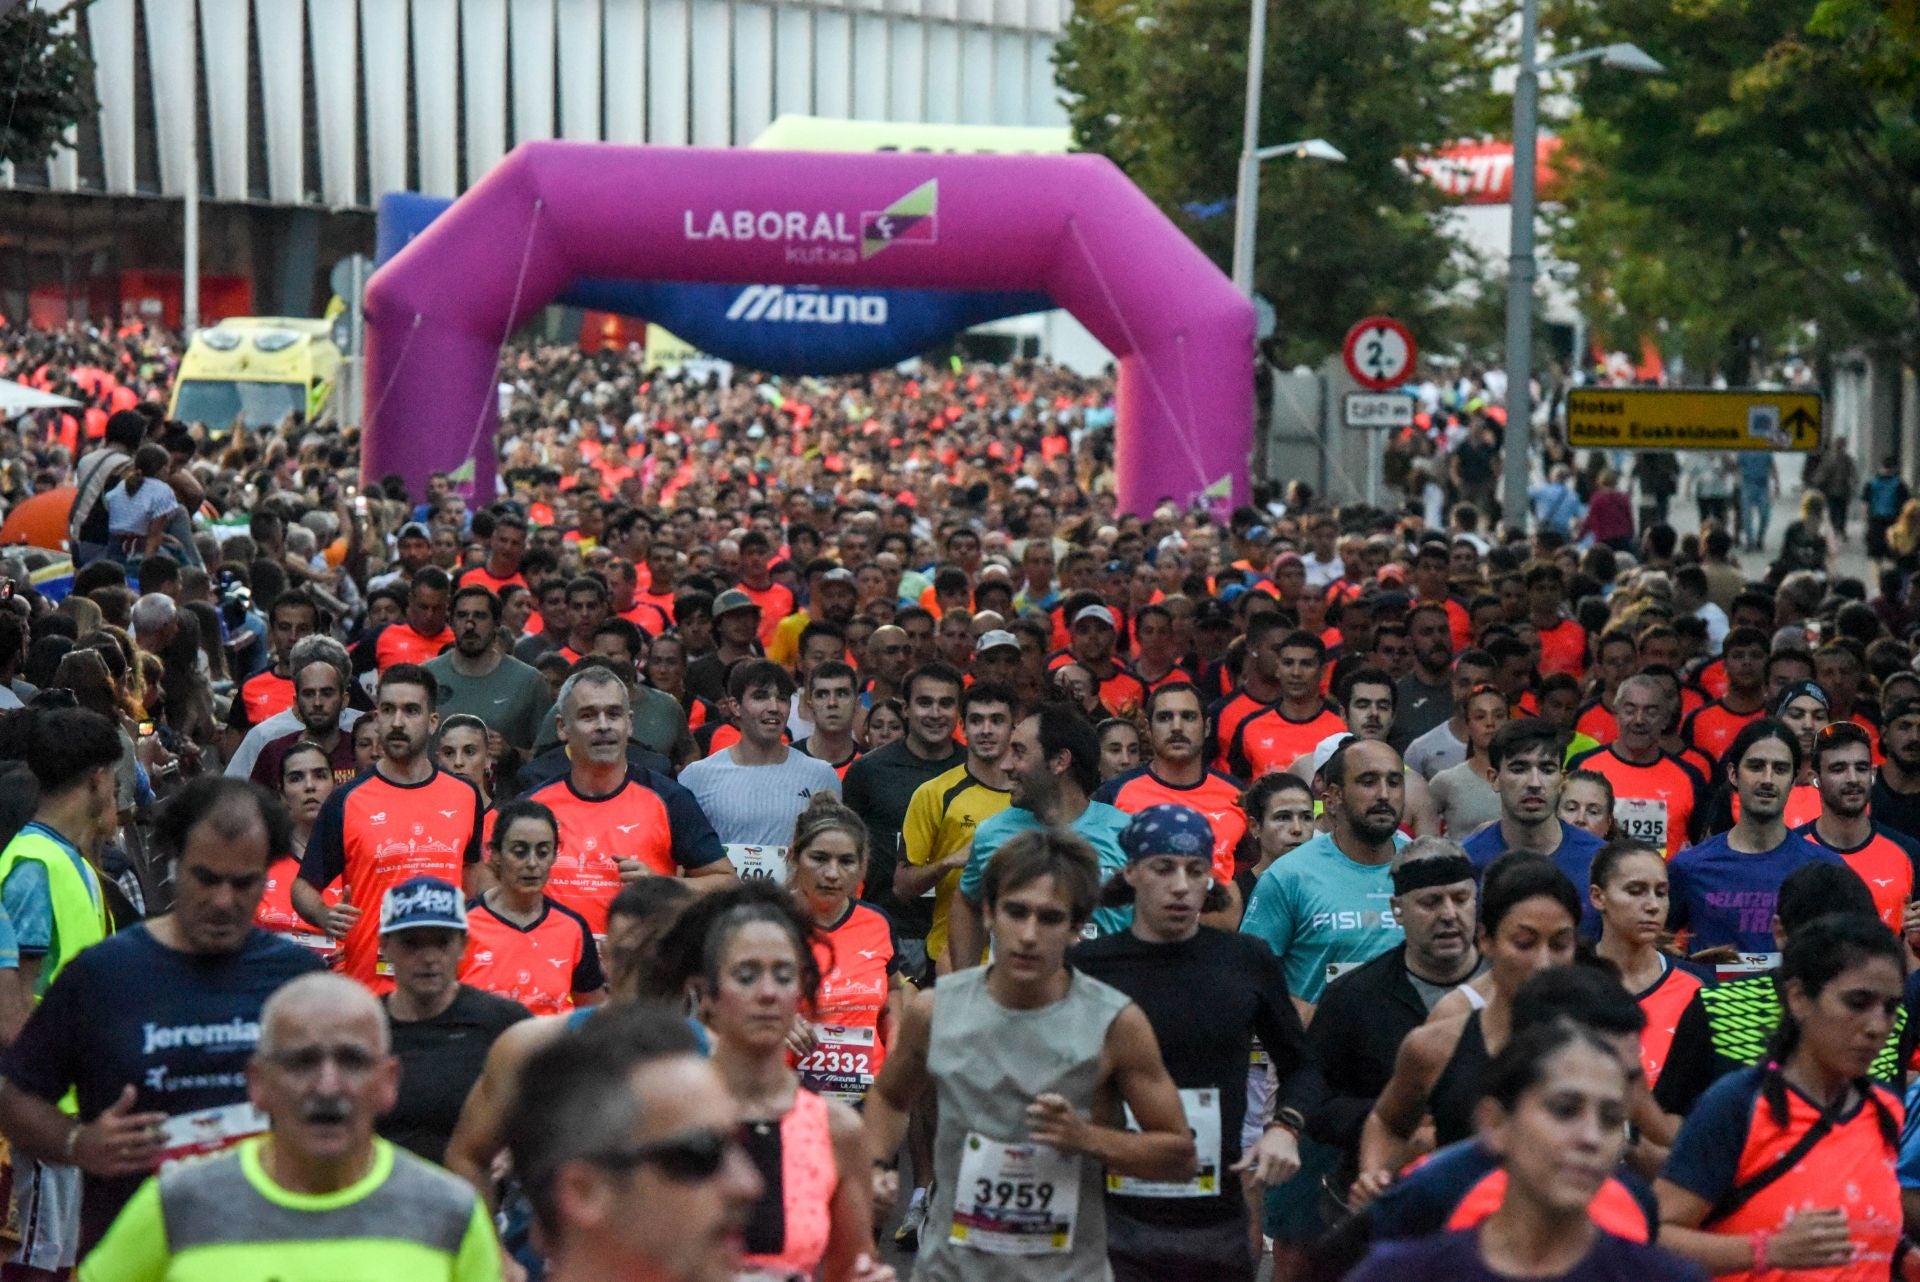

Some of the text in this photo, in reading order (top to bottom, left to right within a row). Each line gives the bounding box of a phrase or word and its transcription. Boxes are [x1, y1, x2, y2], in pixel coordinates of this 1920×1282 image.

[684, 209, 856, 241] LABORAL
[785, 245, 857, 264] kutxa
[1572, 401, 1624, 415] Hotel
[1622, 819, 1664, 835] 1935
[797, 1051, 869, 1074] 22332
[974, 1177, 1054, 1209] 3959
